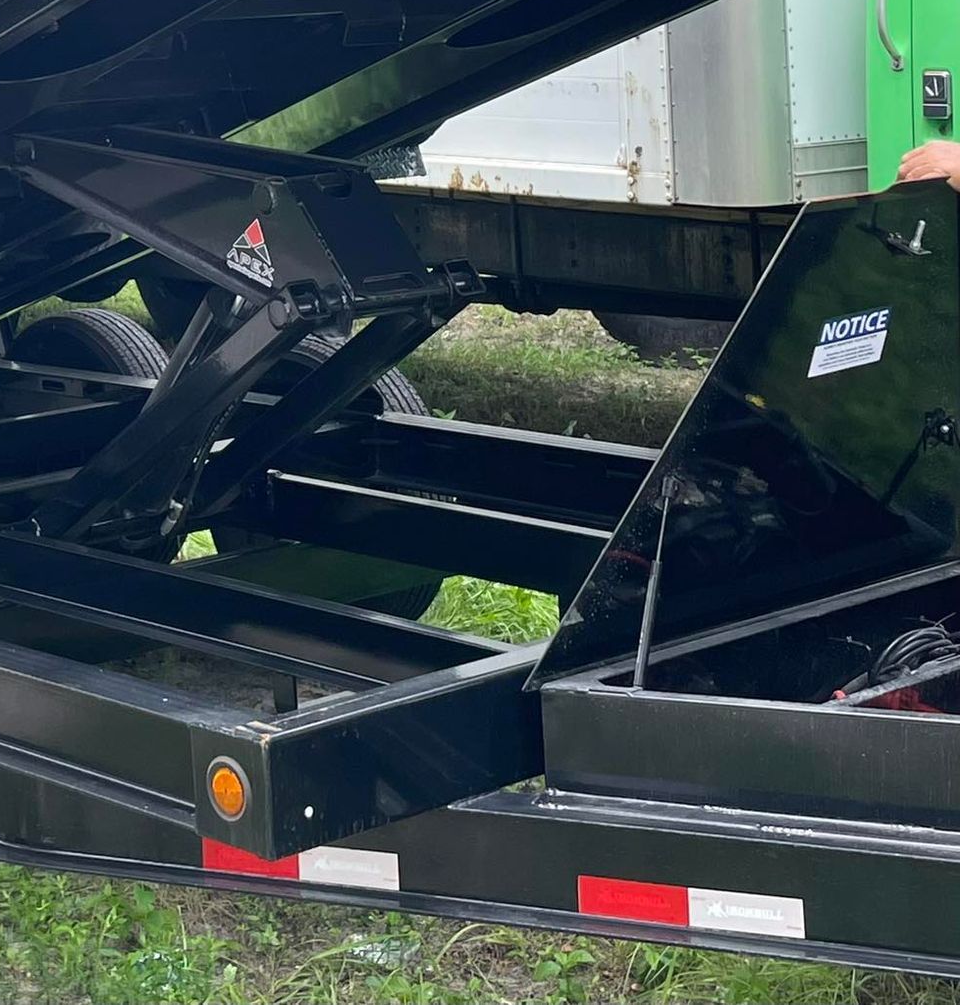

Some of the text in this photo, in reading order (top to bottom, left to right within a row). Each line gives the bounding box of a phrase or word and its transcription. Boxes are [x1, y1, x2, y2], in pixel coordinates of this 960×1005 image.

[227, 247, 275, 281] APEX
[820, 309, 889, 342] NOTICE
[725, 904, 784, 921] IRONBULL
